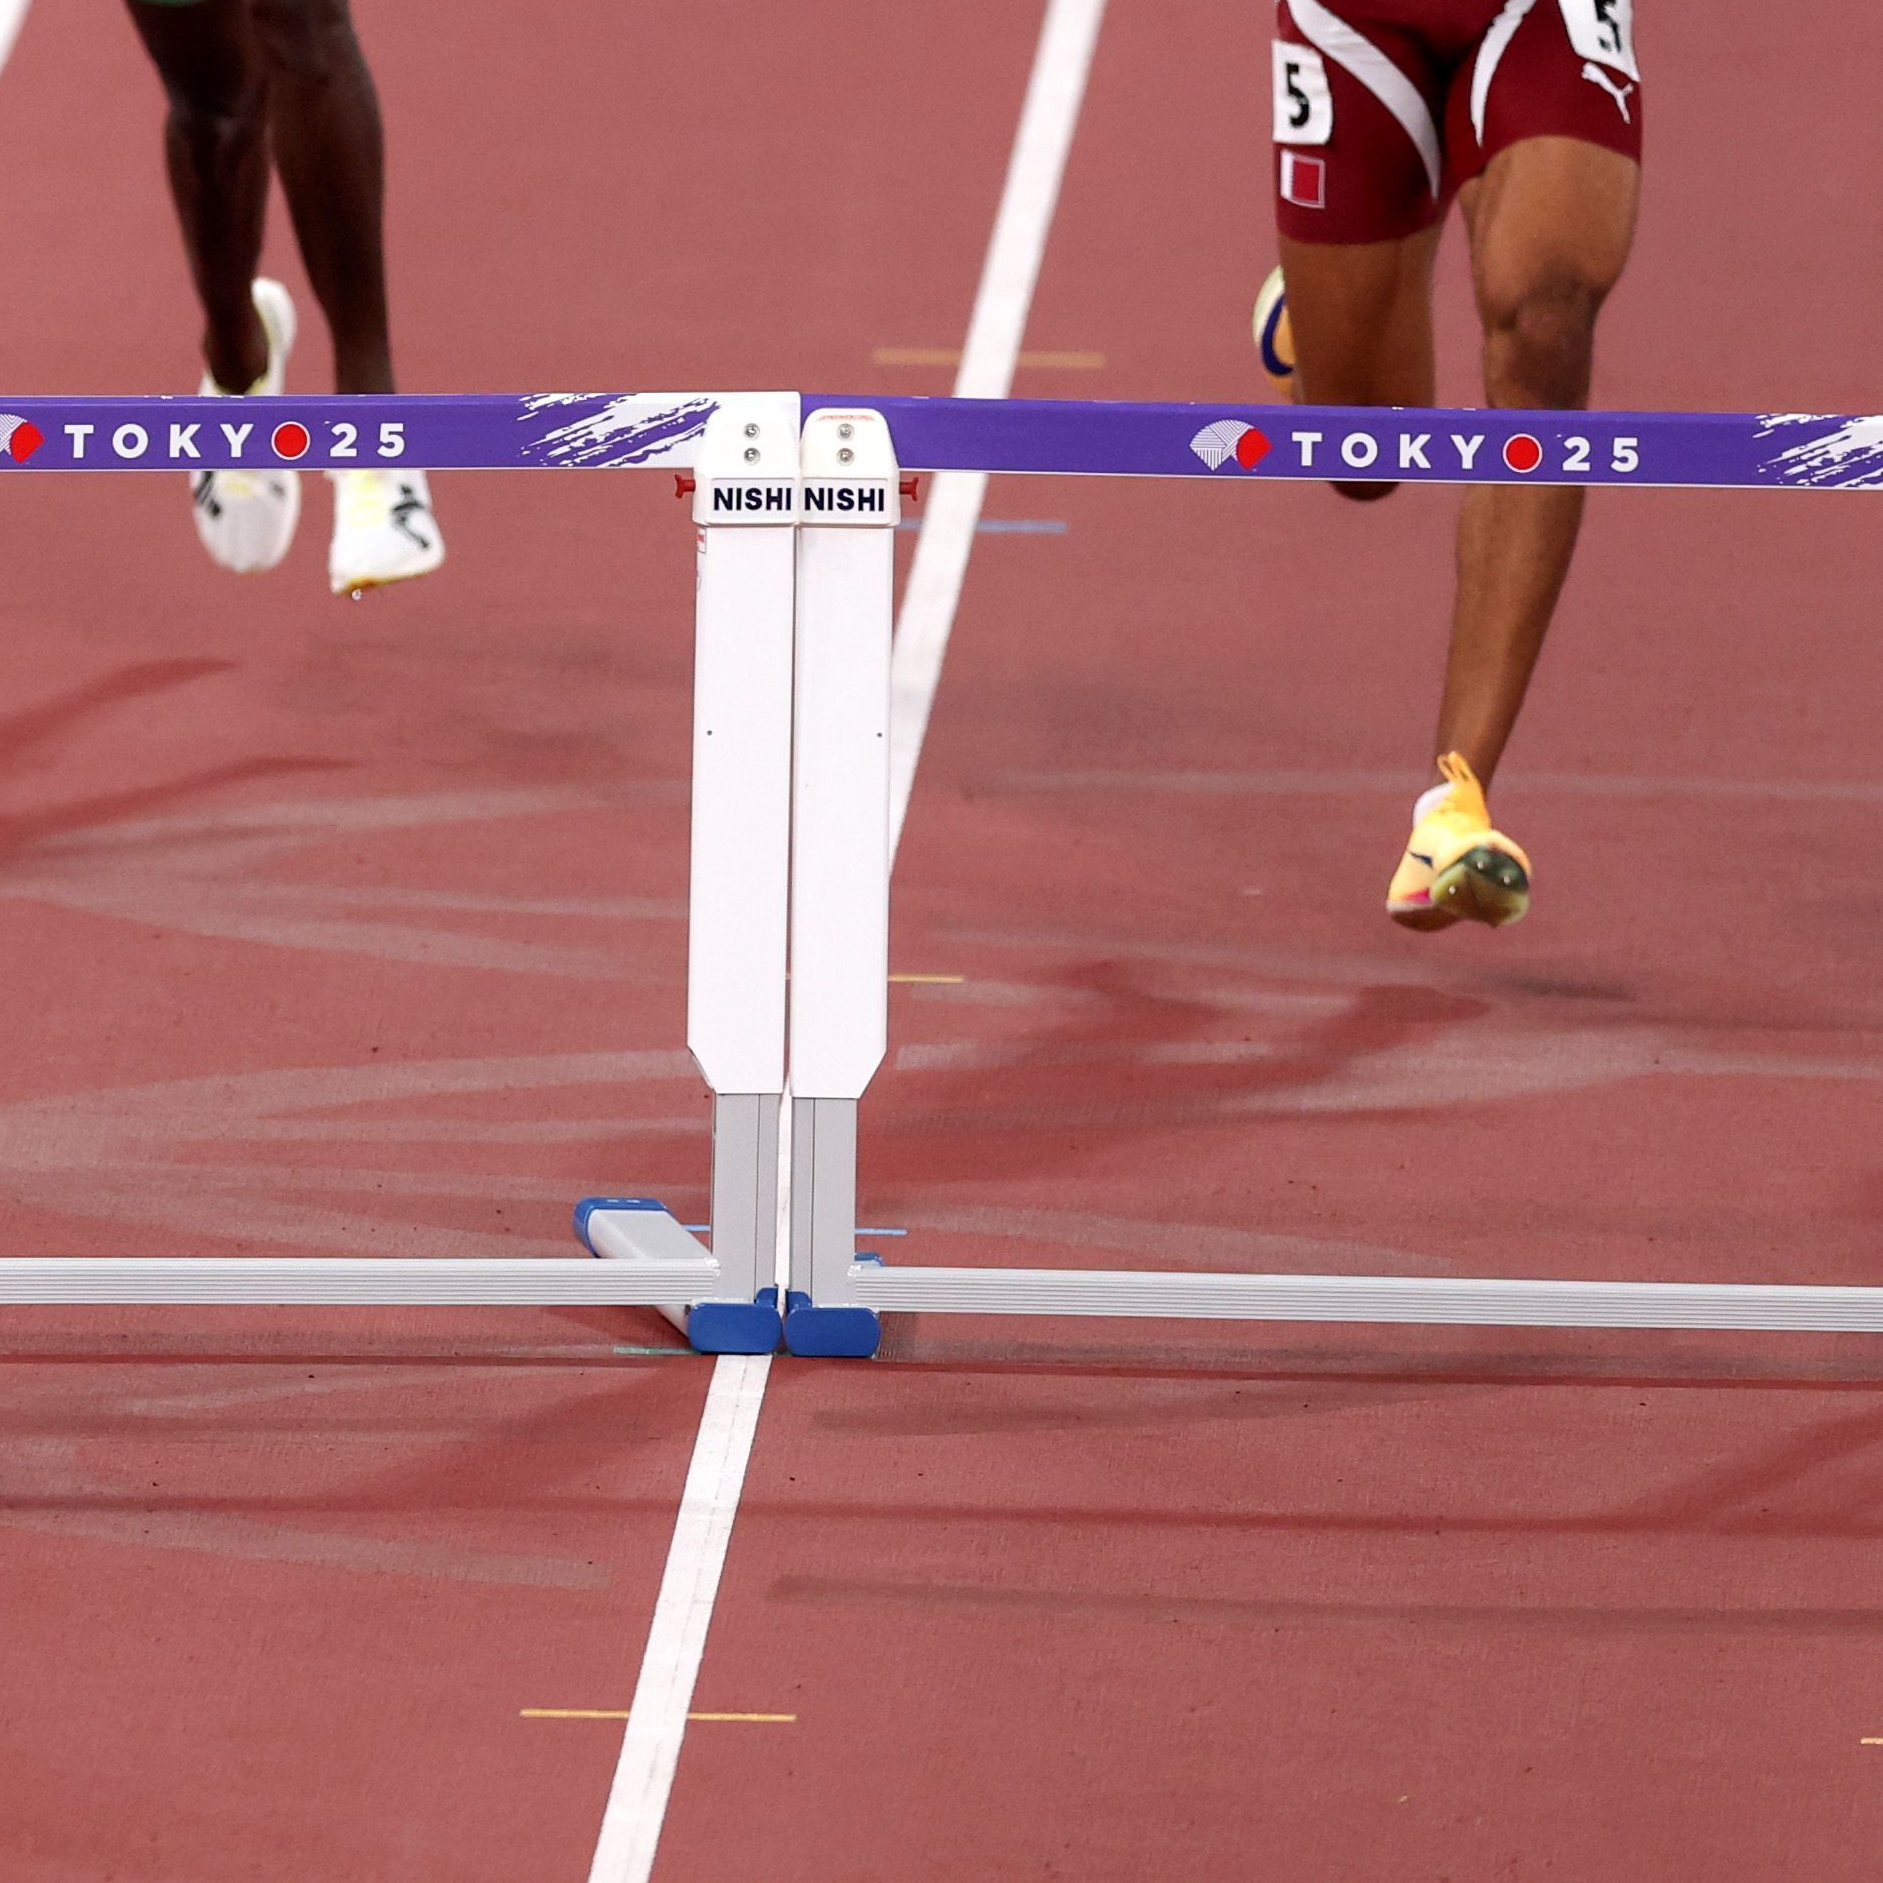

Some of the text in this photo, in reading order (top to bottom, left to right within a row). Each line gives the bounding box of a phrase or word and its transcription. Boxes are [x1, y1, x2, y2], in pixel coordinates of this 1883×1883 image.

[1285, 62, 1311, 129] 5
[713, 486, 792, 512] NISHI
[803, 486, 885, 513] NISHI
